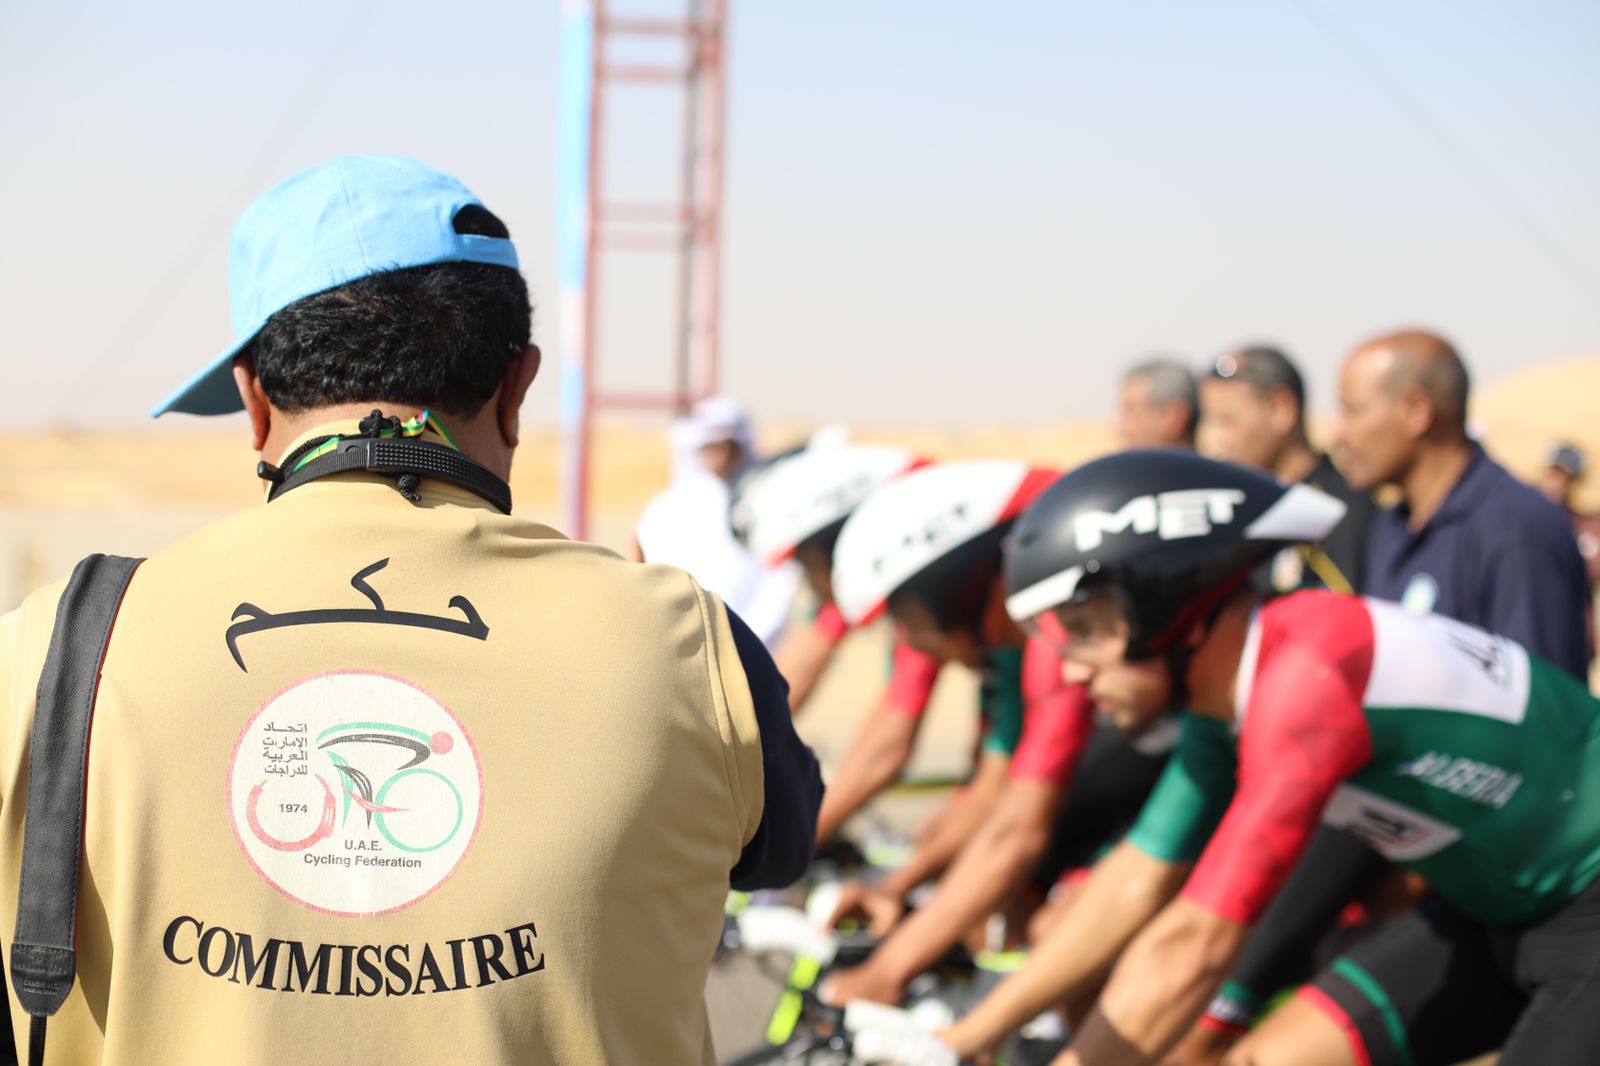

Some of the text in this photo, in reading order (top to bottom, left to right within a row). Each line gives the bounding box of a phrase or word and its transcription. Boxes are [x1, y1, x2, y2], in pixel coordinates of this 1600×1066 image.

[1073, 487, 1246, 553] MET
[225, 557, 489, 673] حكم
[262, 747, 308, 763] العربية
[264, 764, 308, 778] للدراجات
[279, 803, 308, 814] 1974
[344, 840, 383, 852] U.A.E.
[303, 853, 422, 869] Cycling Federation
[162, 915, 545, 997] COMMISSAIRE
